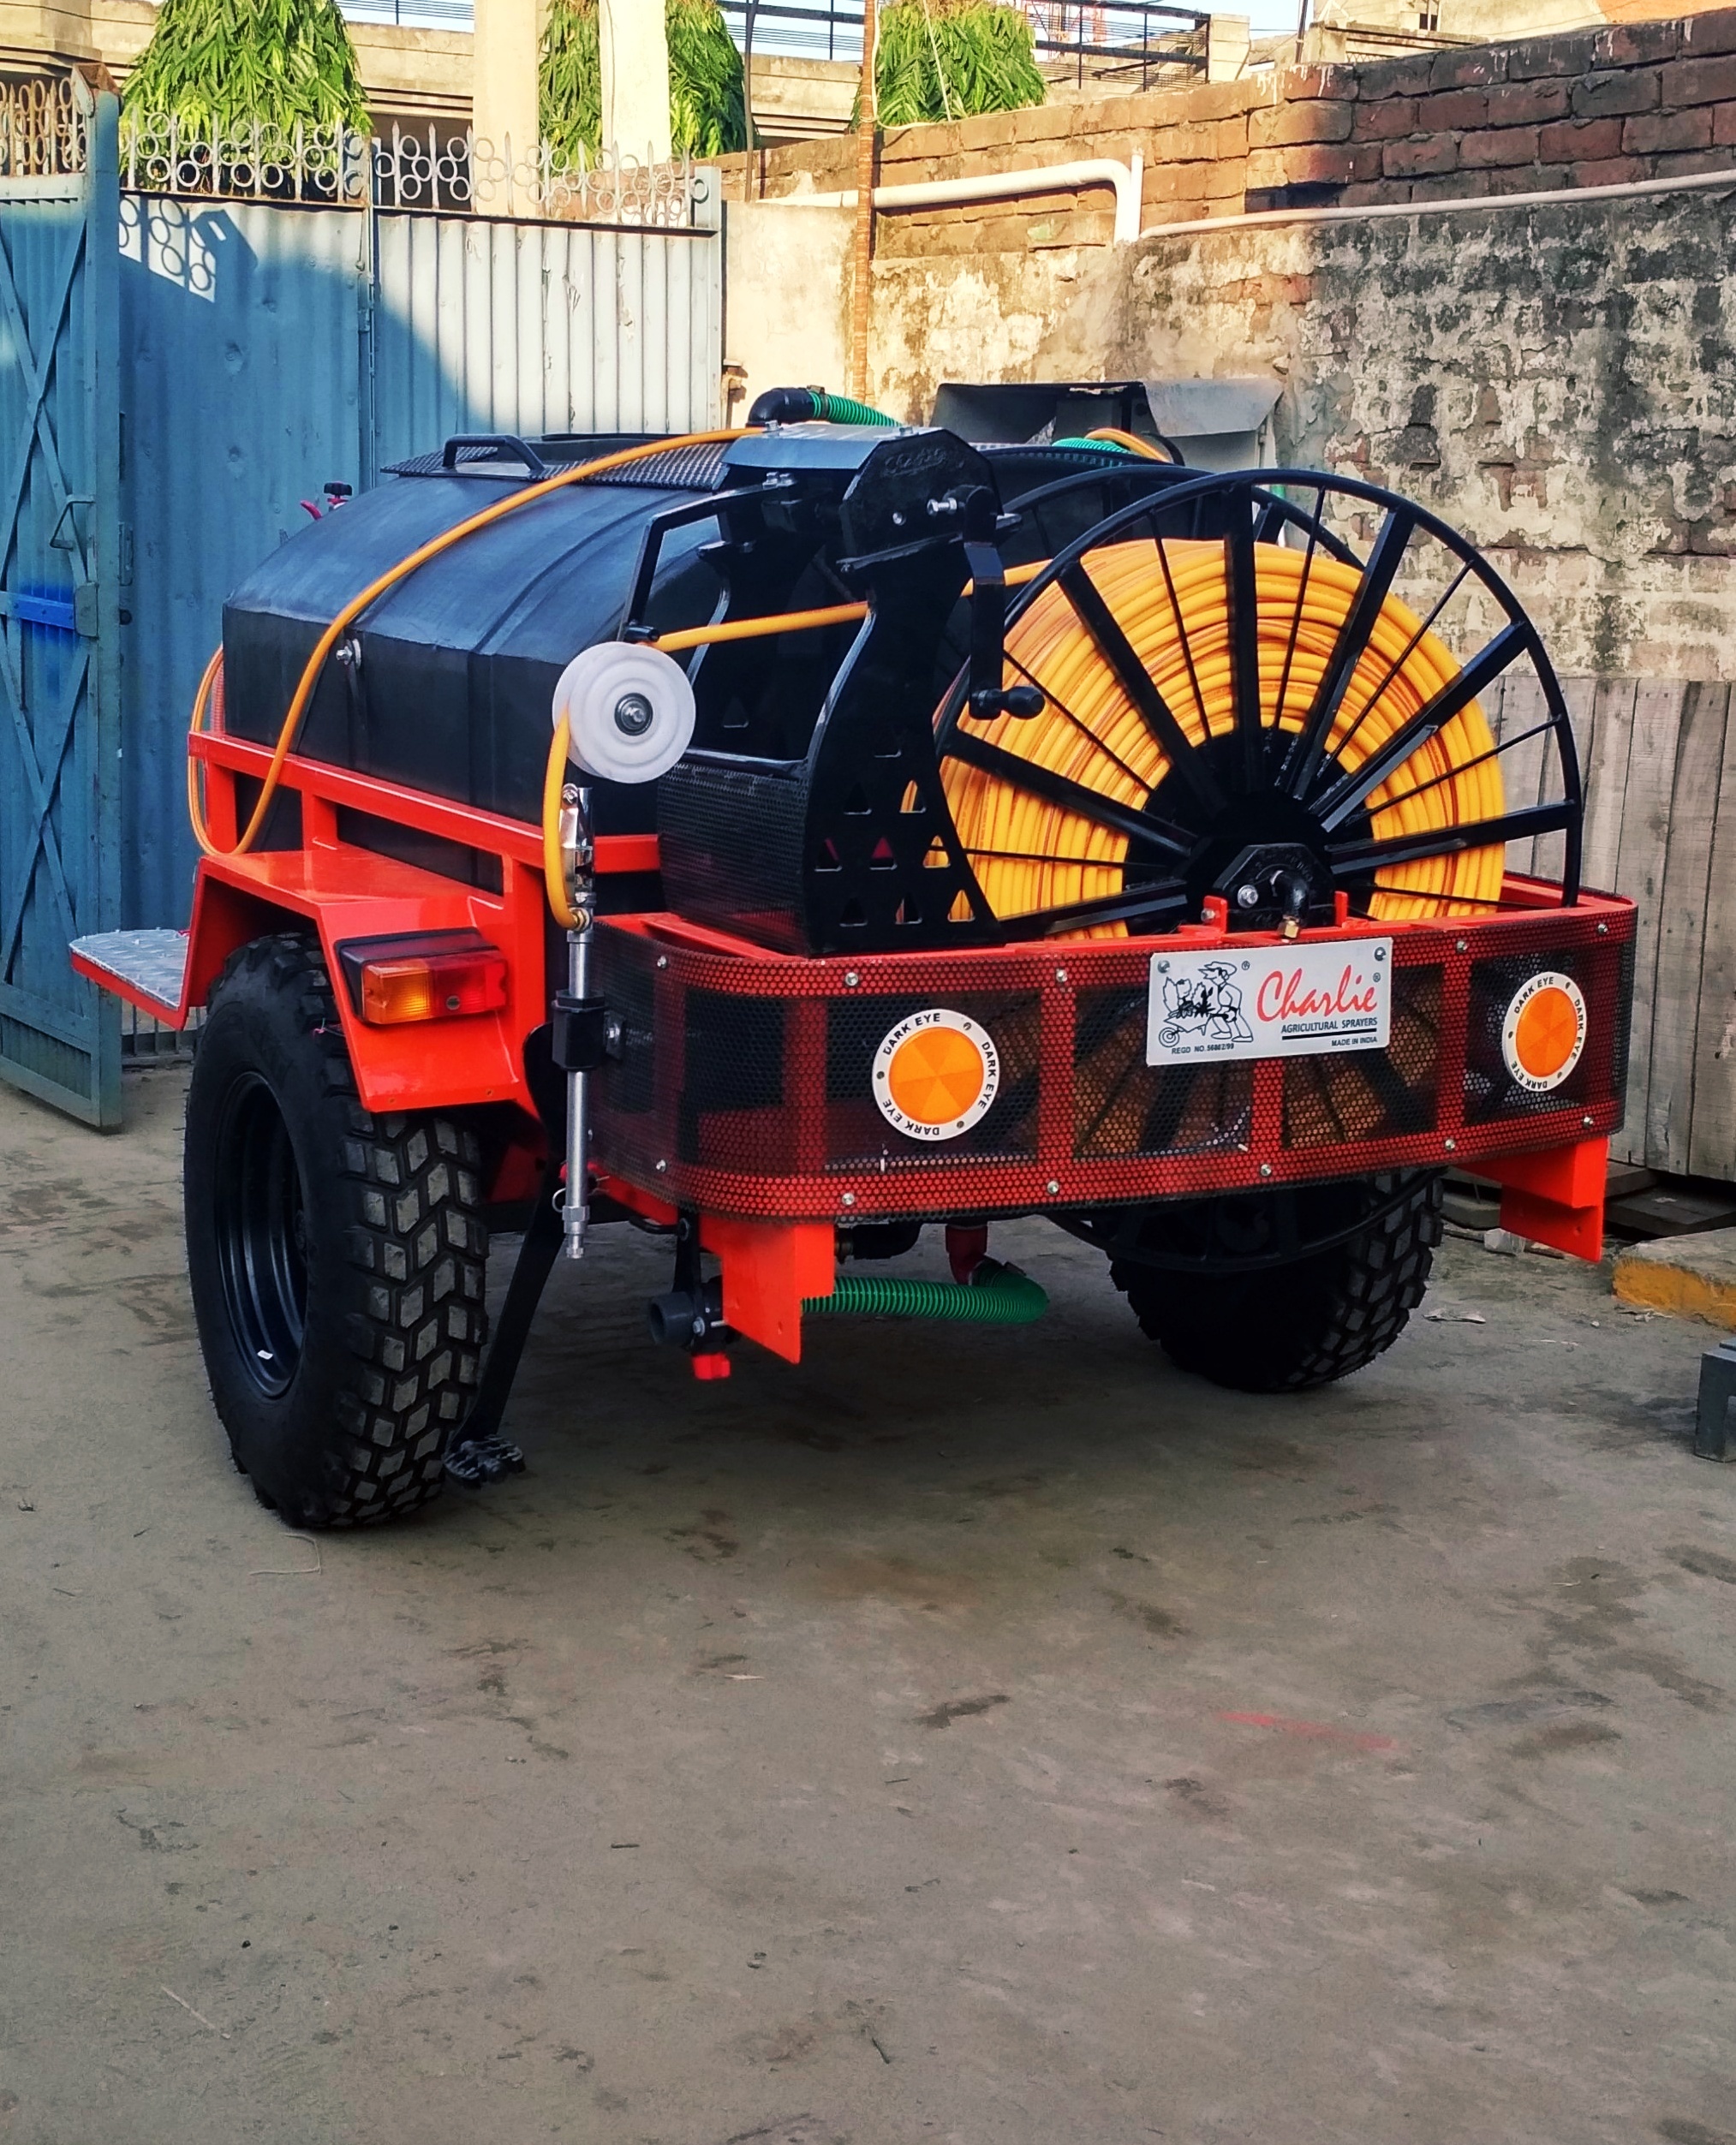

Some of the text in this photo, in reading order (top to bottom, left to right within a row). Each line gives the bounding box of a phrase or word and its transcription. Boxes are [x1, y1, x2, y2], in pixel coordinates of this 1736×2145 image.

[1256, 964, 1378, 1022] Charlie
[1513, 976, 1554, 1014] DARK EYE
[882, 1013, 940, 1056] DARK EYE
[1280, 1017, 1377, 1034] AGRICULTURAL SPRAYERS
[1331, 1038, 1351, 1046] MADE
[1572, 998, 1584, 1060] DARK EYE
[977, 1041, 996, 1109] DARK EYE
[1511, 1061, 1548, 1089] DARK EYE
[882, 1099, 940, 1135] DARK EYE
